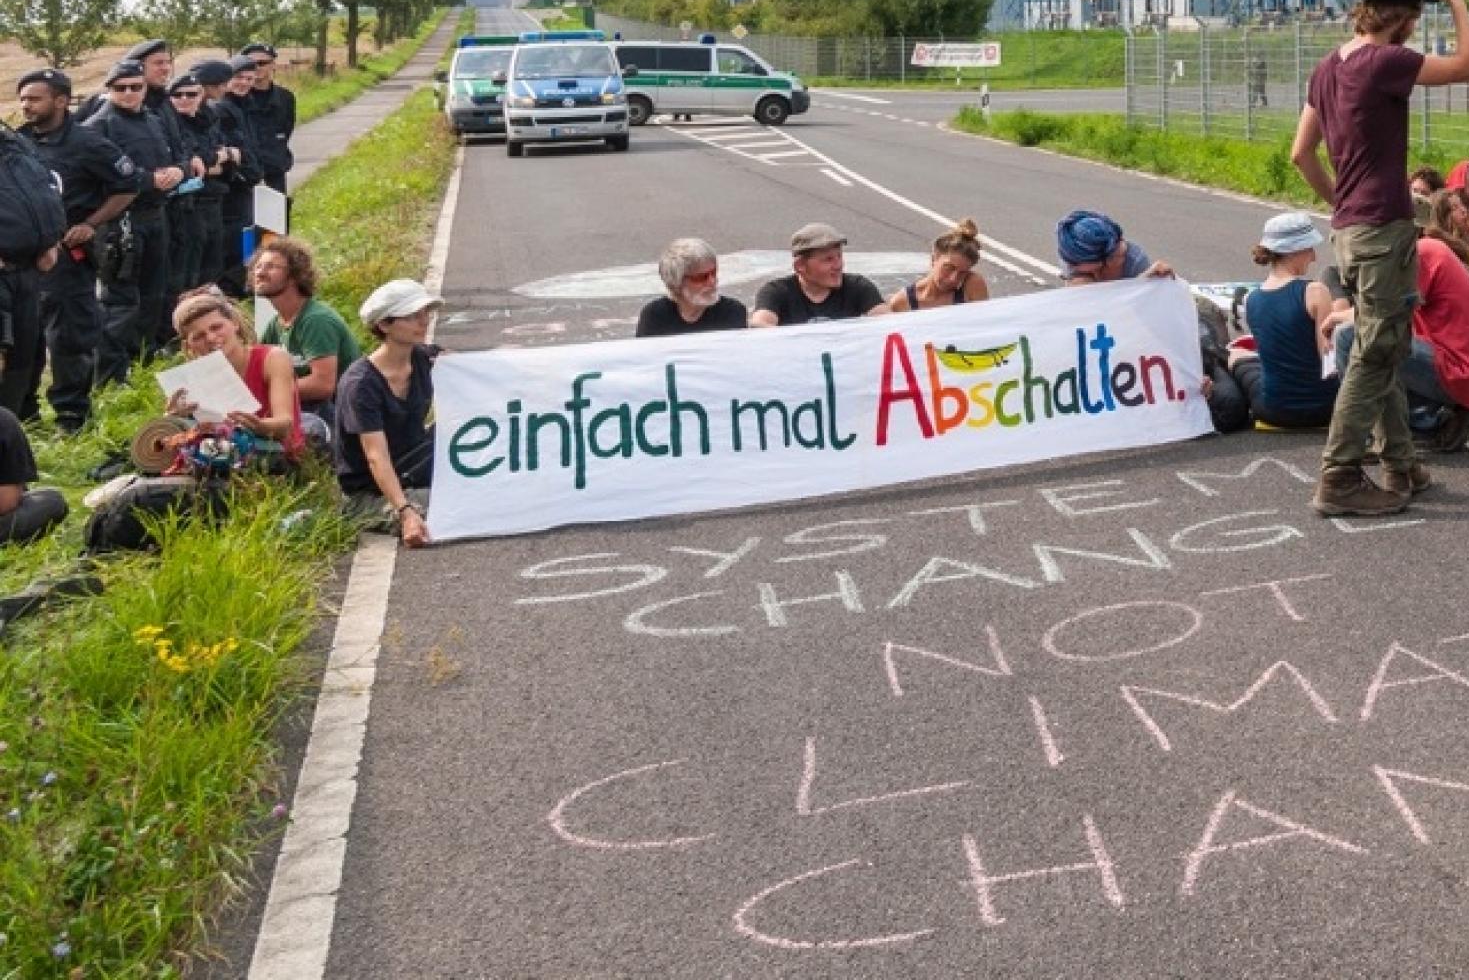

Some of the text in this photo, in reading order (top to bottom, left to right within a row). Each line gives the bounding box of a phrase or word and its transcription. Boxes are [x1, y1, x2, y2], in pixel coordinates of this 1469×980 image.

[447, 323, 1187, 490] einfach mal Abschalten.
[513, 456, 1318, 605] SYSTEM
[884, 573, 1333, 696] NOT
